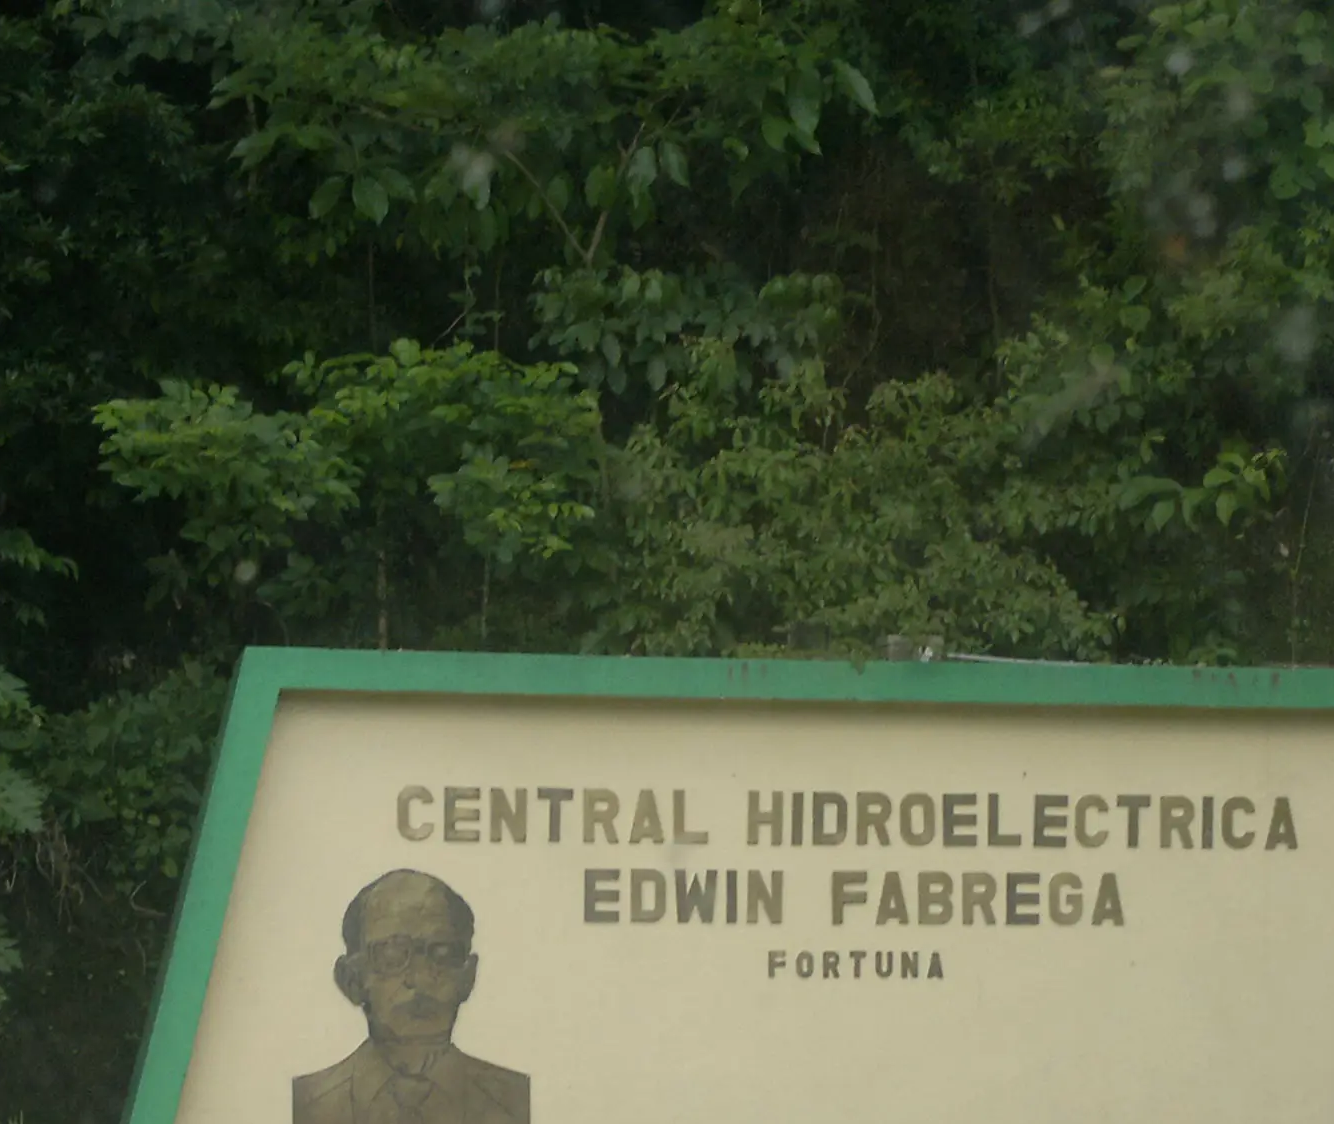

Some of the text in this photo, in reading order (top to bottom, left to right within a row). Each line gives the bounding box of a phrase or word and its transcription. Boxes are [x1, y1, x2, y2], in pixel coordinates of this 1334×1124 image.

[395, 785, 1300, 852] CENTRAL HIDROELECTRICA
[581, 867, 1127, 928] EDWIN FABREGA
[766, 949, 946, 981] FORTUNA
